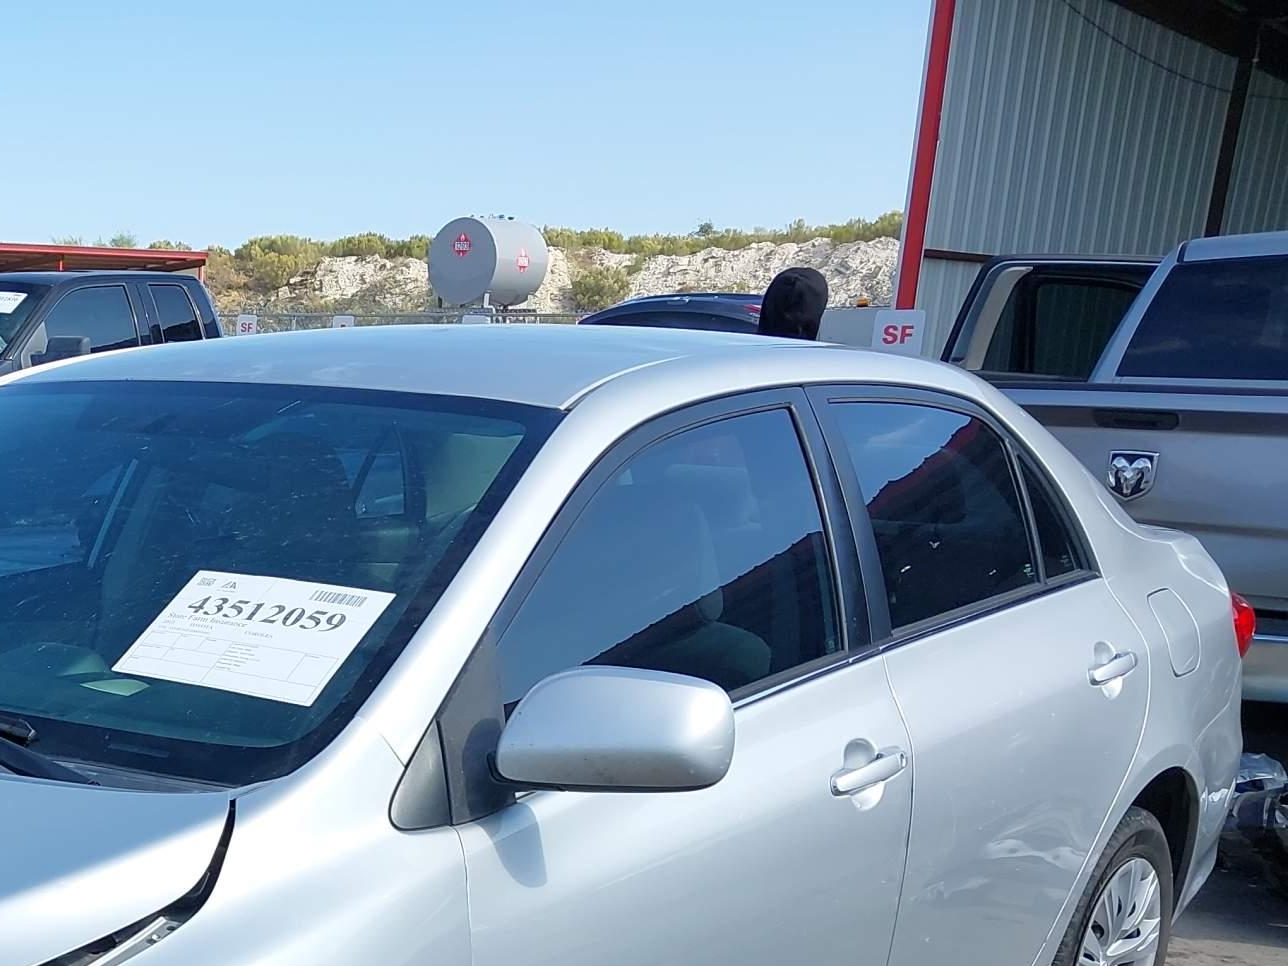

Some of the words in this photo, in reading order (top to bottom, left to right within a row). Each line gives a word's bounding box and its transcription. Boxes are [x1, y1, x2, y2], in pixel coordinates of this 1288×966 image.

[240, 322, 254, 333] SF
[882, 325, 914, 345] SF
[187, 595, 346, 632] 43512059
[188, 614, 209, 623] Farm
[209, 617, 249, 629] Insurance
